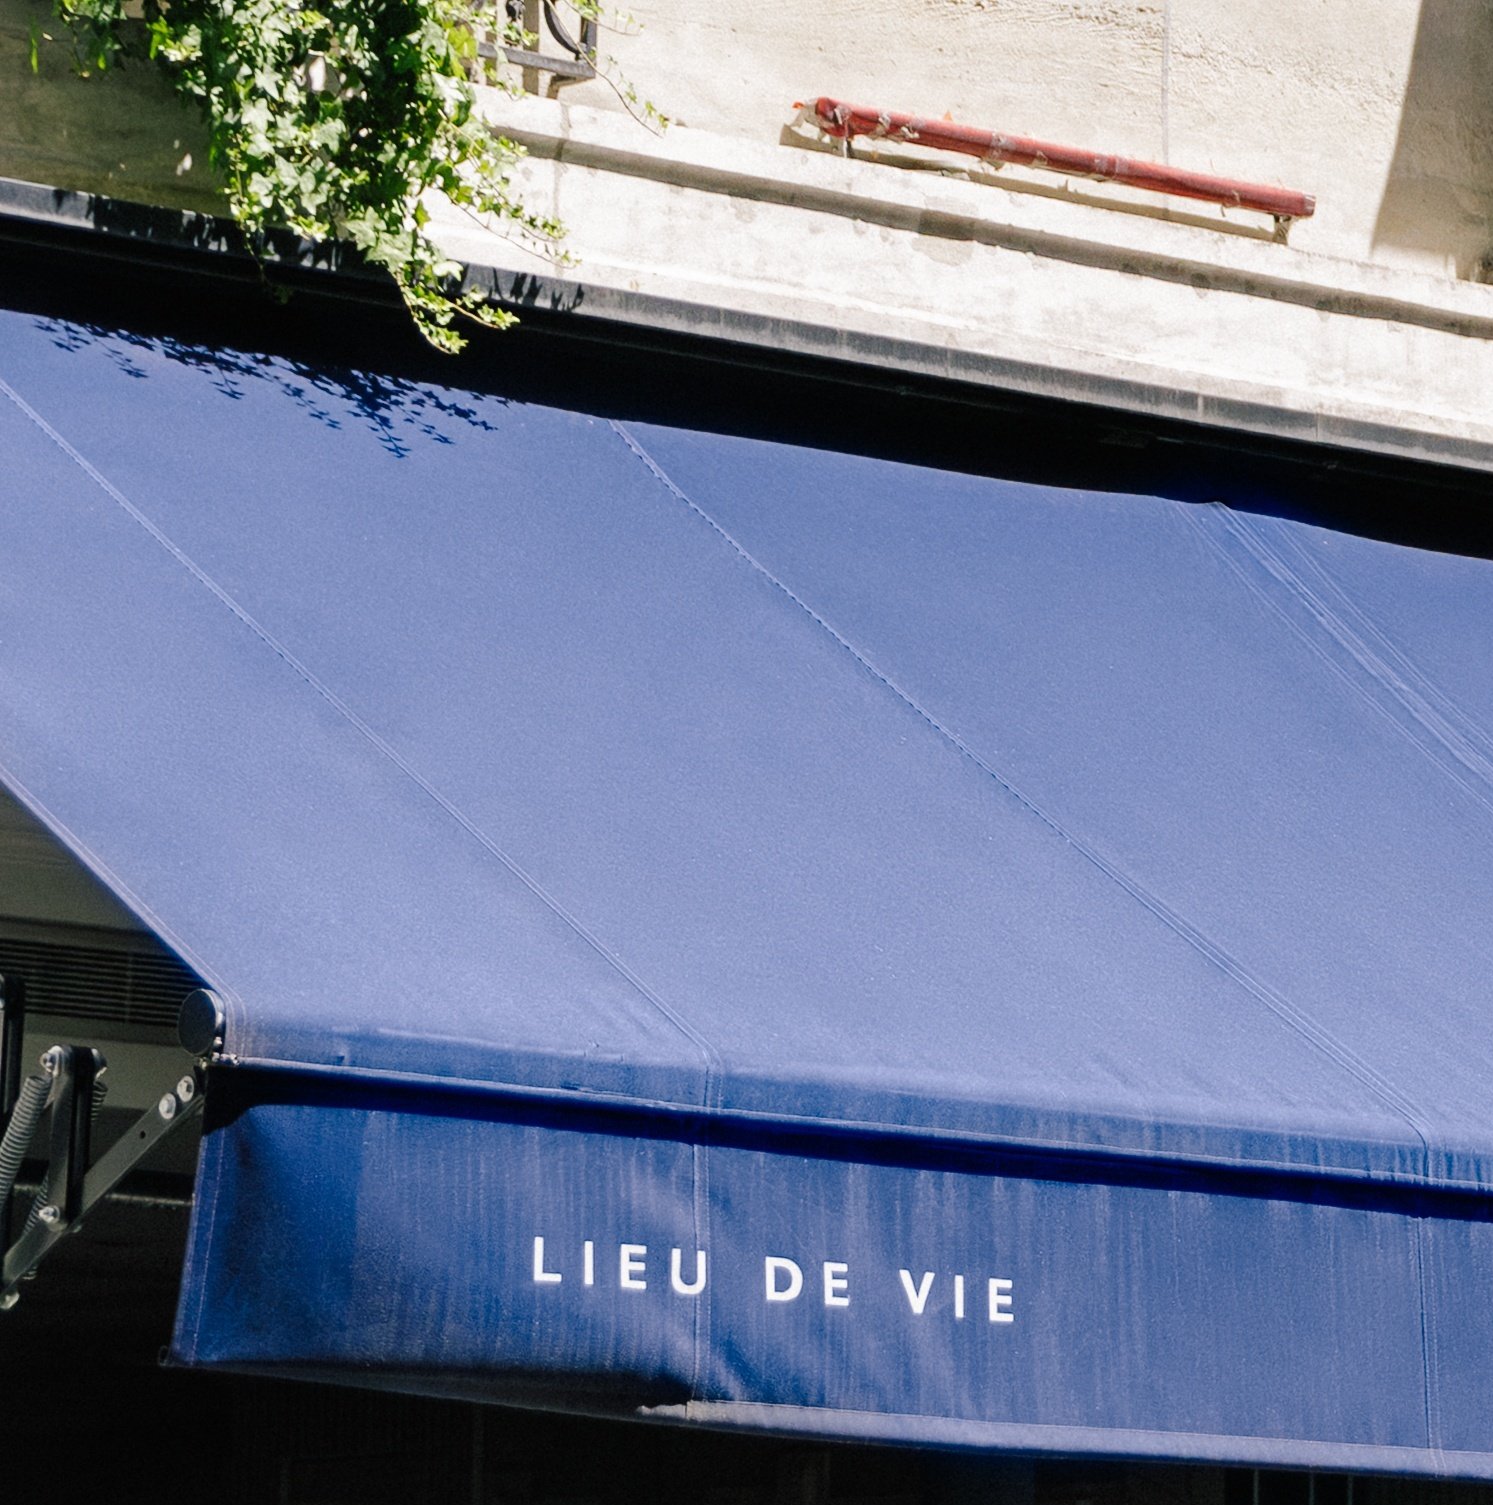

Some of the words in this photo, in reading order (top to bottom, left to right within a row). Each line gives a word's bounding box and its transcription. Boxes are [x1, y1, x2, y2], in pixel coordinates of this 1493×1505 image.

[532, 1235, 708, 1296] LIEU
[764, 1255, 851, 1308] DE
[898, 1268, 1015, 1323] VIE
